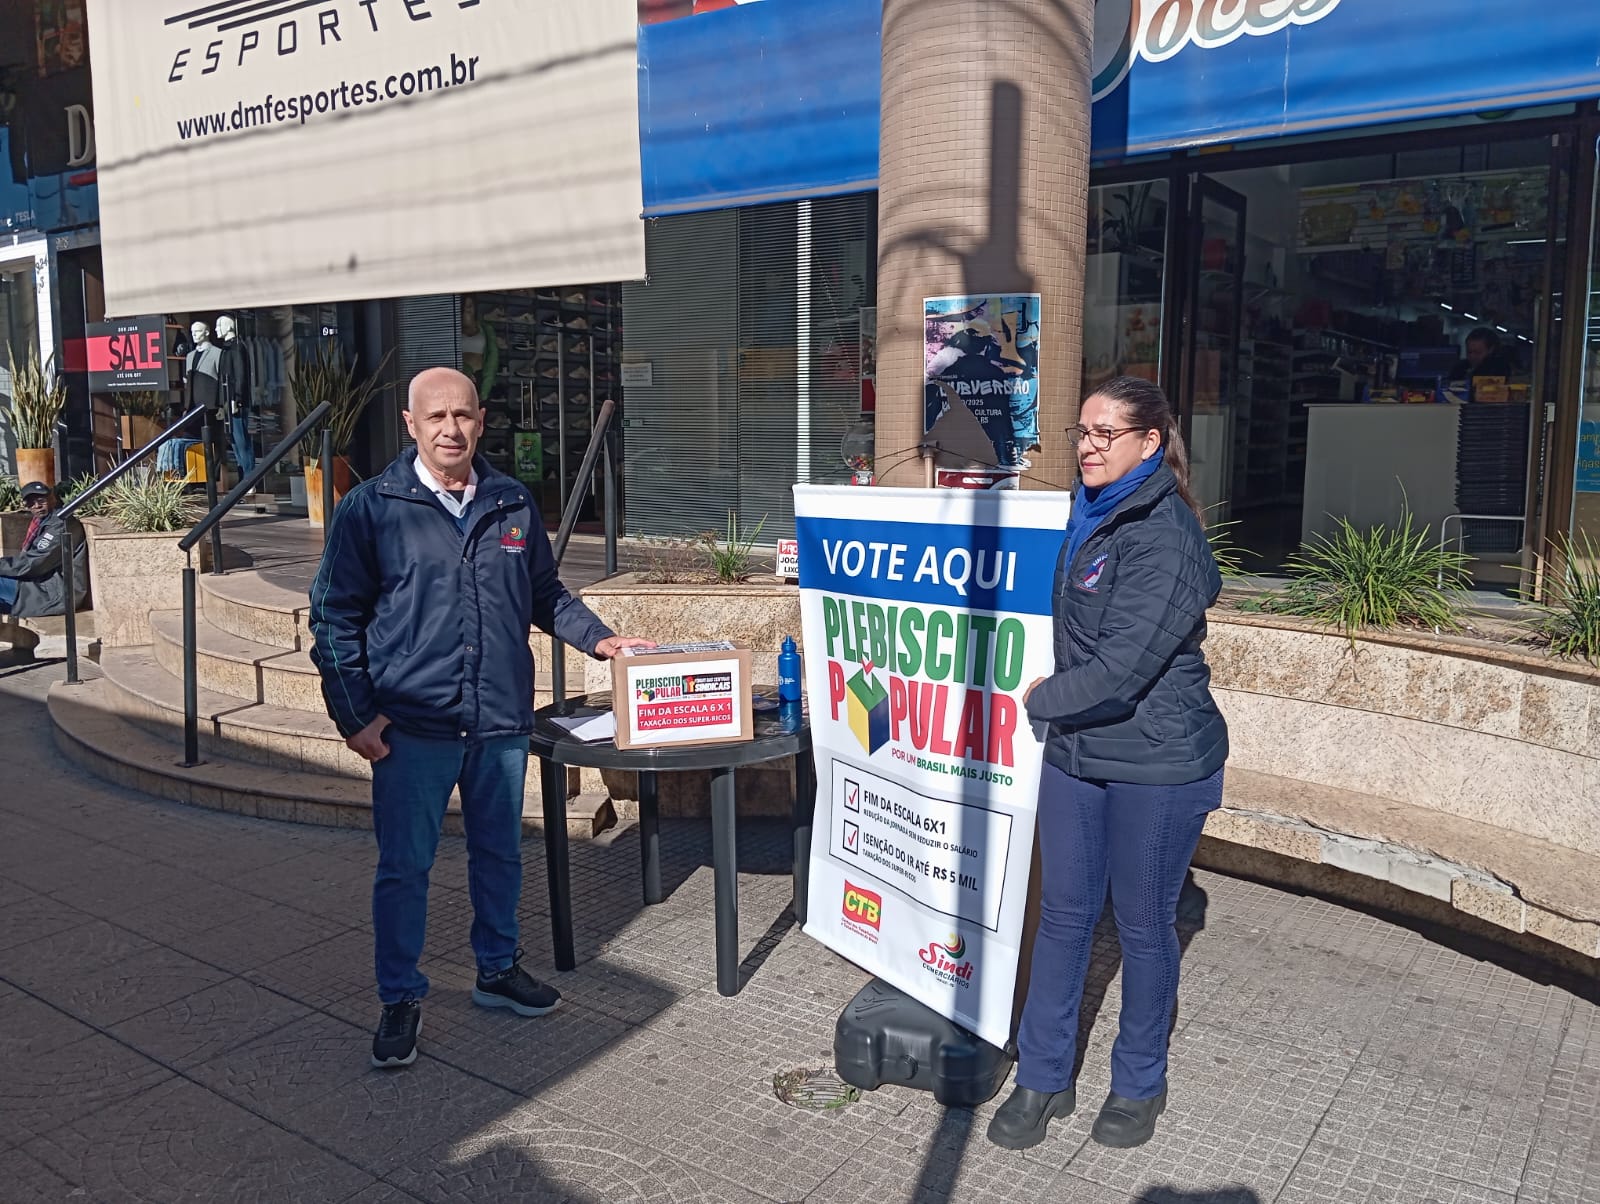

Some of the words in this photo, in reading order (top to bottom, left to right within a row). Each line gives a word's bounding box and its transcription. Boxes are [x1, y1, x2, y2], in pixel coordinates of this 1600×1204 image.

[167, 0, 480, 83] ESPORTE
[177, 52, 479, 140] www.dmfesportes.com.br
[108, 332, 162, 370] SALE
[974, 408, 1002, 417] CULTURA
[822, 538, 908, 582] VOTE
[913, 545, 1017, 597] AQUI
[823, 595, 1025, 692] PLEBISCITO
[636, 676, 681, 689] PLEBISCITO
[695, 681, 730, 692] SINDICAIS
[639, 707, 656, 717] FIM
[658, 707, 671, 716] DA
[674, 704, 708, 714] ESCALA
[710, 703, 716, 711] 6
[717, 703, 724, 711] X
[726, 702, 731, 710] 1
[640, 717, 672, 727] TAXAÇÃO
[673, 717, 687, 725] DOS
[892, 747, 906, 762] POR
[916, 757, 949, 774] BRASIL
[951, 765, 977, 779] MAIS
[979, 770, 1013, 786] JUSTO
[864, 790, 879, 807] FIM
[880, 797, 892, 814] DA
[894, 803, 921, 829] ESCALA
[923, 818, 946, 835] 6X1
[863, 832, 894, 856] ISENÇÃO
[895, 848, 906, 863] DO
[907, 853, 915, 868] IR
[915, 861, 930, 877] ATÉ
[933, 865, 947, 881] R$
[949, 871, 956, 883] 5
[958, 874, 978, 891] MIL
[917, 836, 942, 849] REDUZIR
[943, 842, 949, 850] O
[950, 844, 978, 858] SALÁRIO
[845, 890, 879, 923] CTB
[918, 942, 974, 981] Sindi
[922, 963, 970, 989] COMERCIÁRIOS
